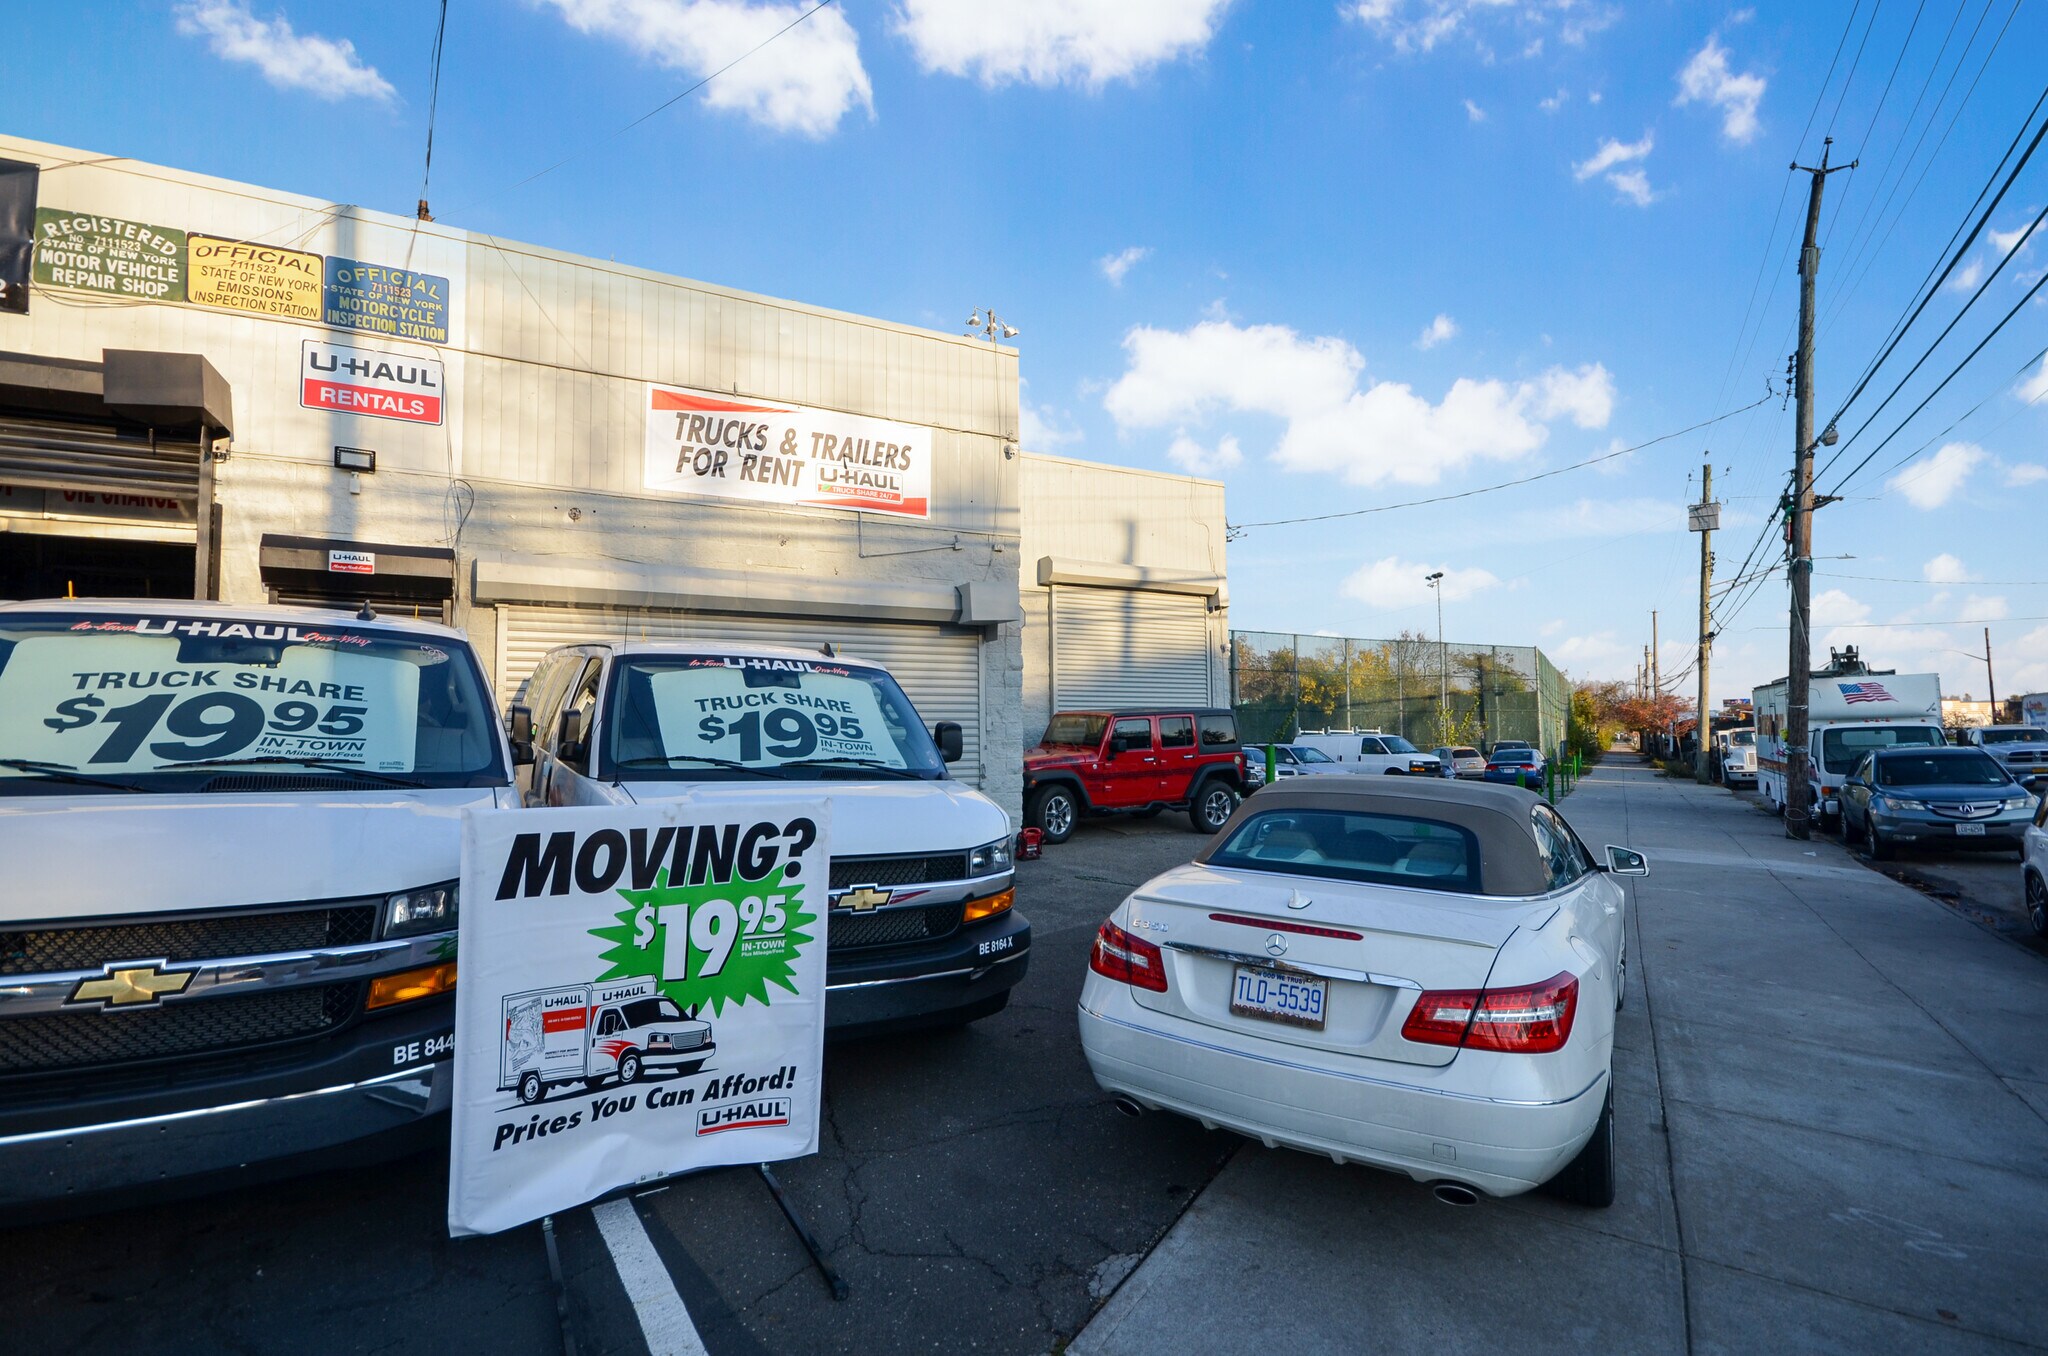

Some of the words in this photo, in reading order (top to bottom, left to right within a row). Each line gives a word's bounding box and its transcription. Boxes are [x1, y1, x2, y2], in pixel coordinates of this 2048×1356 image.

[43, 217, 177, 255] REGISTERED
[69, 234, 85, 244] NO.
[94, 235, 141, 252] 7111523
[43, 239, 83, 252] STATE
[88, 246, 105, 254] OF
[109, 249, 138, 260] NEW
[142, 254, 177, 266] YORK
[195, 245, 316, 276] OFFICIAL
[40, 249, 100, 271] MOTOR
[106, 259, 179, 283] VEHICLE
[230, 260, 277, 274] 7111523
[52, 267, 116, 290] REPAIR
[122, 278, 169, 296] SHOP
[201, 265, 236, 280] STATE
[240, 272, 256, 282] OF
[259, 275, 284, 287] NEW
[287, 279, 318, 293] YORK
[216, 281, 293, 301] EMISSIONS
[337, 268, 440, 300] OFFICIAL
[372, 282, 412, 298] 7111523
[194, 290, 266, 310] INSPECTION
[270, 302, 318, 318] STATION
[331, 285, 364, 297] STATE
[368, 291, 383, 299] OF
[387, 295, 411, 305] NEW
[415, 300, 443, 311] YORK
[339, 296, 435, 324] MOTORCYCLE
[327, 309, 397, 333] INSPECTION
[400, 322, 445, 341] STATION
[310, 352, 436, 388] U-HAUL
[320, 387, 425, 415] RENTALS
[675, 412, 769, 452] TRUCKS
[779, 428, 798, 456] &
[810, 432, 913, 471] TRAILERS
[675, 445, 729, 478] FOR
[740, 454, 805, 487] RENT
[820, 468, 900, 490] U-HAUL
[832, 486, 855, 495] TRUCK
[857, 489, 878, 498] SHARE
[333, 554, 371, 562] U-HAUL
[136, 619, 309, 642] U-HAUL
[723, 657, 818, 673] U-HAUL
[72, 670, 222, 690] TRUCK
[233, 672, 366, 702] SHARE
[694, 692, 778, 712] TRUCK
[783, 693, 852, 714] SHARE
[255, 747, 283, 755] Plus
[285, 749, 364, 758] Mileage/Fees
[259, 736, 365, 751] IN-TOWN
[820, 739, 873, 752] IN-TOWN
[836, 748, 877, 757] Mileage/Fees
[495, 818, 817, 901] MOVING?
[742, 940, 786, 951] IN-TOWN
[979, 942, 990, 955] BE
[991, 938, 1007, 952] 8164
[1007, 936, 1013, 948] X
[1263, 972, 1275, 980] GOD
[544, 995, 583, 1008] U-HAUL
[602, 986, 647, 1001] U-HAUL
[1238, 976, 1322, 1014] TLD-5539
[394, 1042, 420, 1065] BE
[493, 1110, 582, 1151] Prices
[591, 1096, 637, 1122] You
[646, 1087, 695, 1109] Can
[701, 1066, 797, 1102] Afford!
[702, 1101, 786, 1126] U-HAUL
